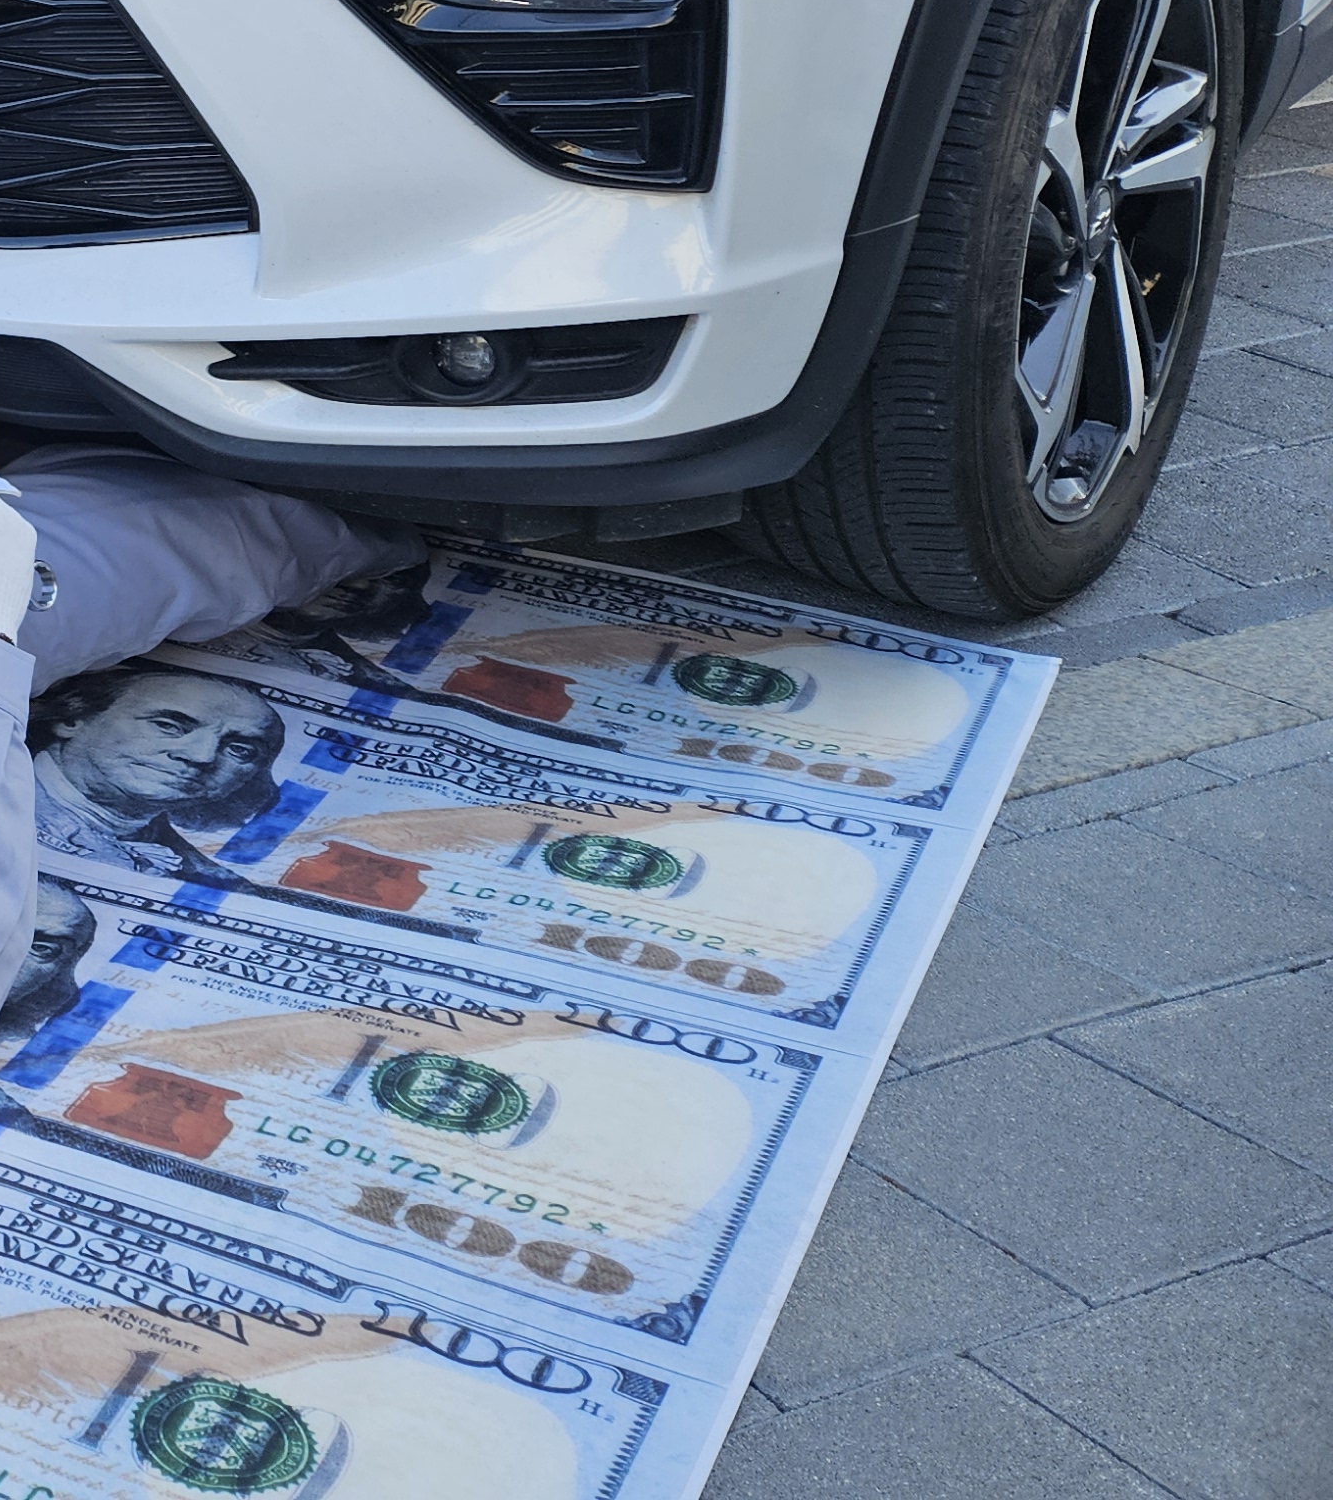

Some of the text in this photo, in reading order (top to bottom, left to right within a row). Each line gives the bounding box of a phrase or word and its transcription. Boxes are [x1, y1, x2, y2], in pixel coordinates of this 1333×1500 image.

[804, 620, 967, 666] 100
[590, 695, 842, 755] LG04727792
[674, 736, 897, 788] 100
[698, 793, 877, 838] 100
[446, 881, 728, 951] LG04727792
[171, 974, 198, 985] FOR
[199, 980, 225, 992] ALL
[533, 922, 787, 997] 100
[555, 1000, 759, 1065] 100
[256, 1115, 572, 1225] LG04727792
[344, 1182, 634, 1296] 100
[39, 1278, 55, 1289] IS
[57, 1282, 104, 1309] LEGAL
[106, 1299, 173, 1337] TENDER
[77, 1236, 327, 1337] STATES
[39, 1288, 98, 1315] PUBLIC
[99, 1308, 134, 1333] AND
[136, 1323, 203, 1353] PRIVATE
[360, 1298, 593, 1395] 100
